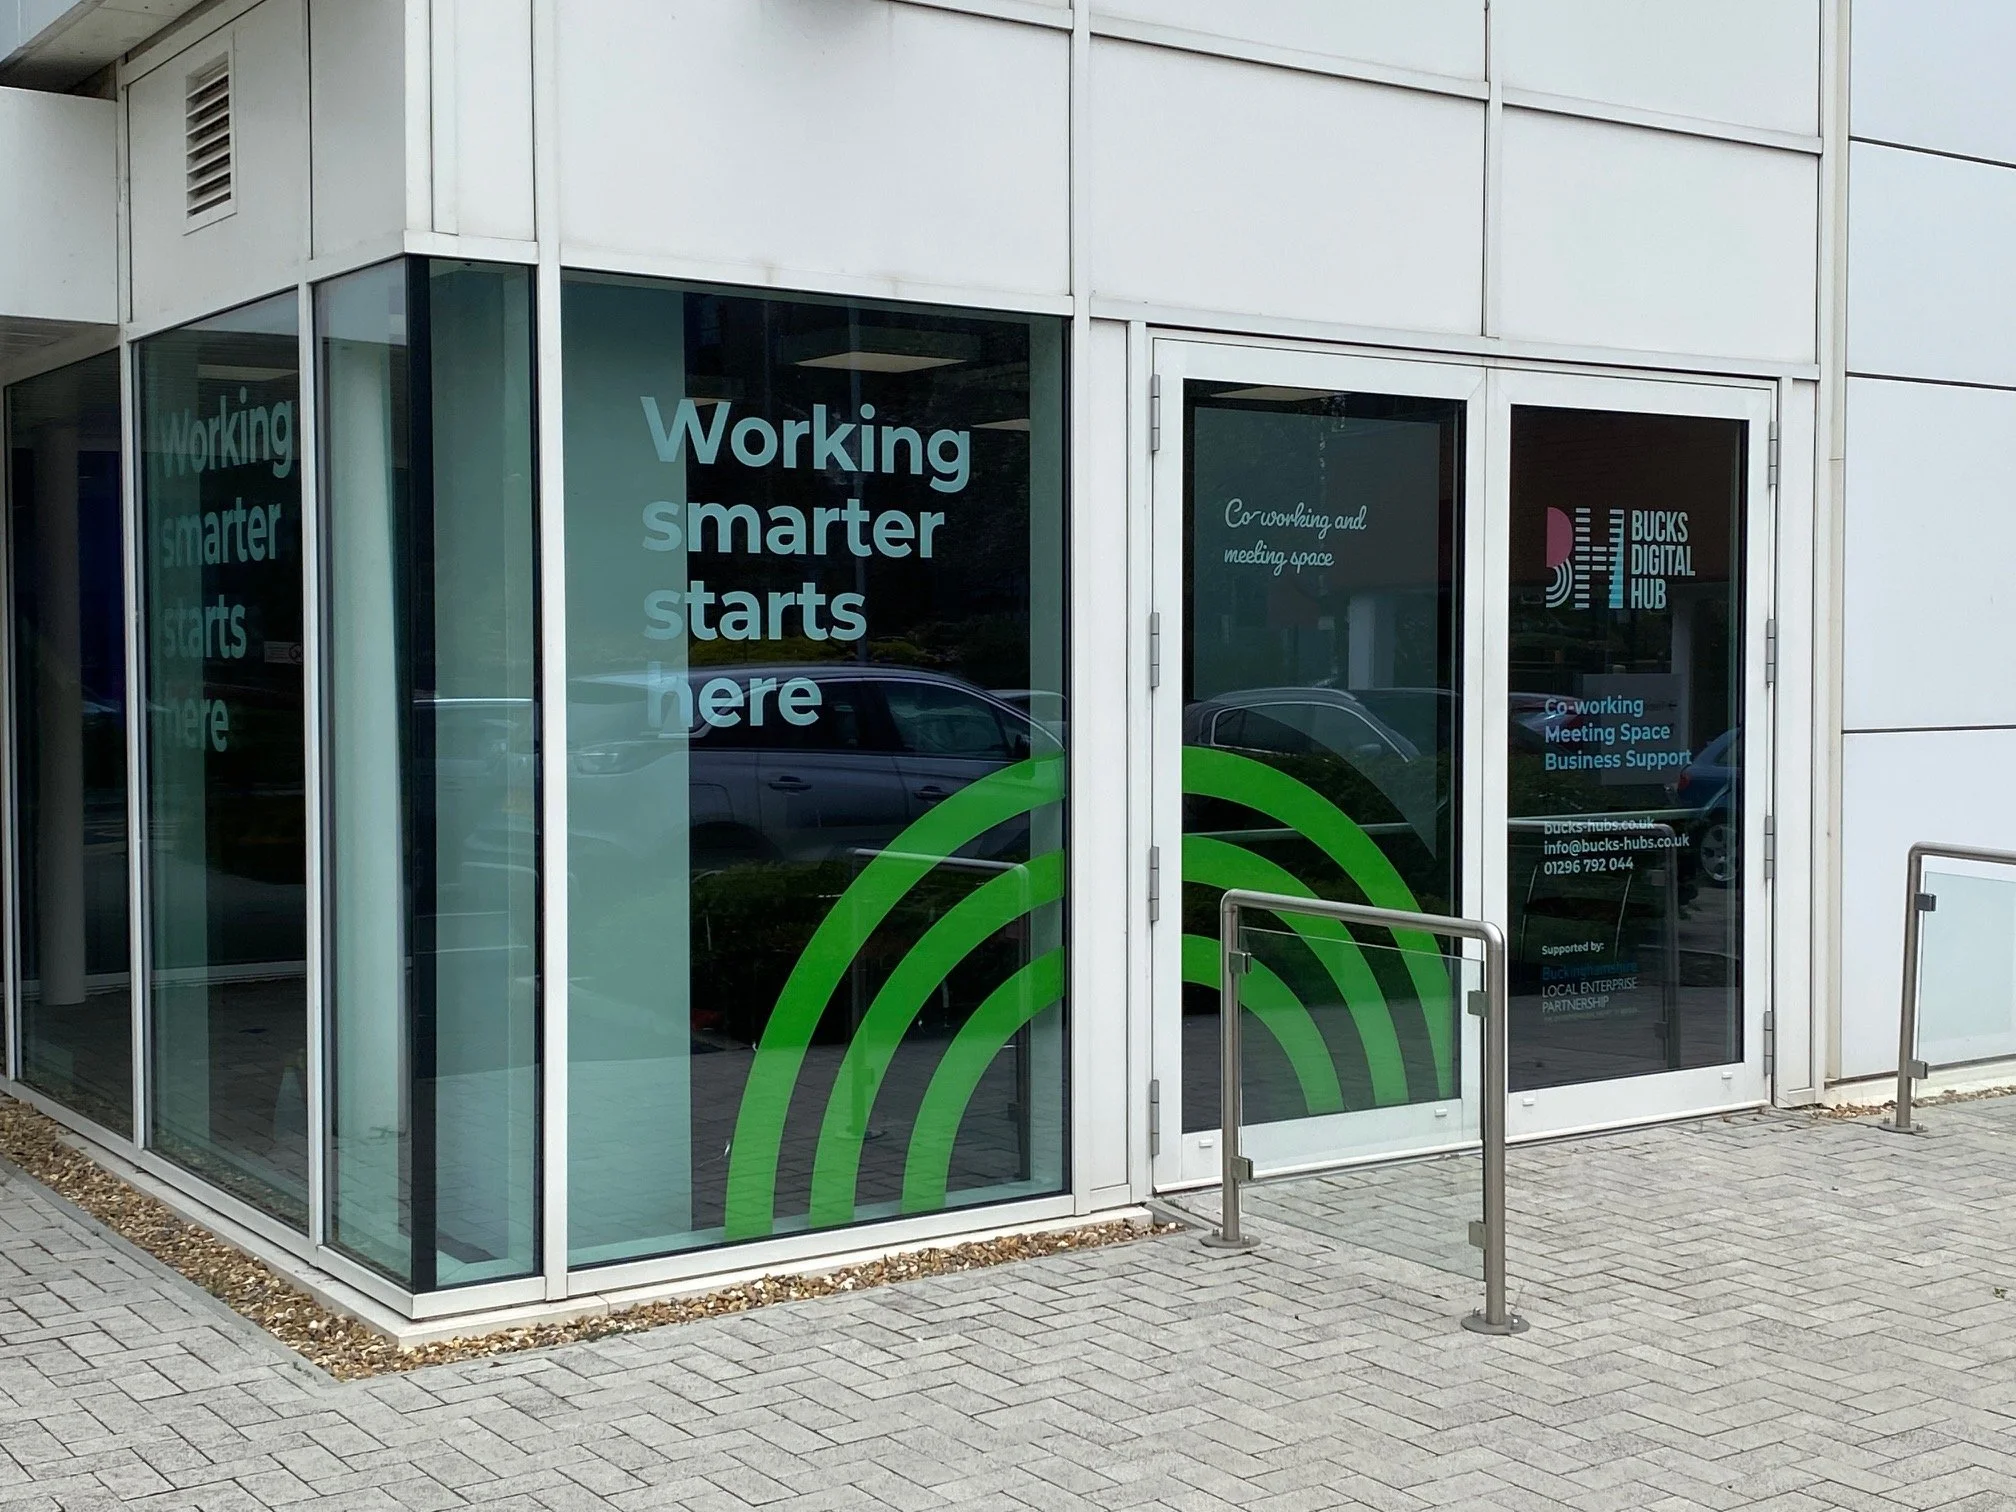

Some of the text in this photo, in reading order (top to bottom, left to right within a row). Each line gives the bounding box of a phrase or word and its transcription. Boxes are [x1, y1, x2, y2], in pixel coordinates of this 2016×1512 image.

[158, 386, 292, 479] Working
[640, 396, 970, 493] Working
[162, 497, 282, 569] smarter
[642, 498, 945, 559] smarter
[1224, 498, 1368, 540] Co-working and
[1630, 509, 1689, 543] BUCKS
[1224, 540, 1335, 576] meeting space
[1630, 543, 1696, 577] DIGITAL
[643, 580, 867, 641] starts
[1630, 578, 1667, 610] HUB
[163, 594, 247, 660] starts
[648, 661, 823, 729] here
[1544, 695, 1644, 718] Co-working
[1545, 722, 1671, 746] Meeting Space
[1544, 749, 1693, 771] Business Support
[1544, 815, 1655, 835] bucks-hubs.co.uk
[1544, 834, 1690, 857] info@bucks-hubs.co.uk
[1543, 856, 1634, 876] 01296 792 044
[1541, 940, 1605, 957] Supported by:
[1541, 976, 1638, 999] LOCAL ENTERPRISE
[1541, 995, 1610, 1014] PARTNERSHIP
